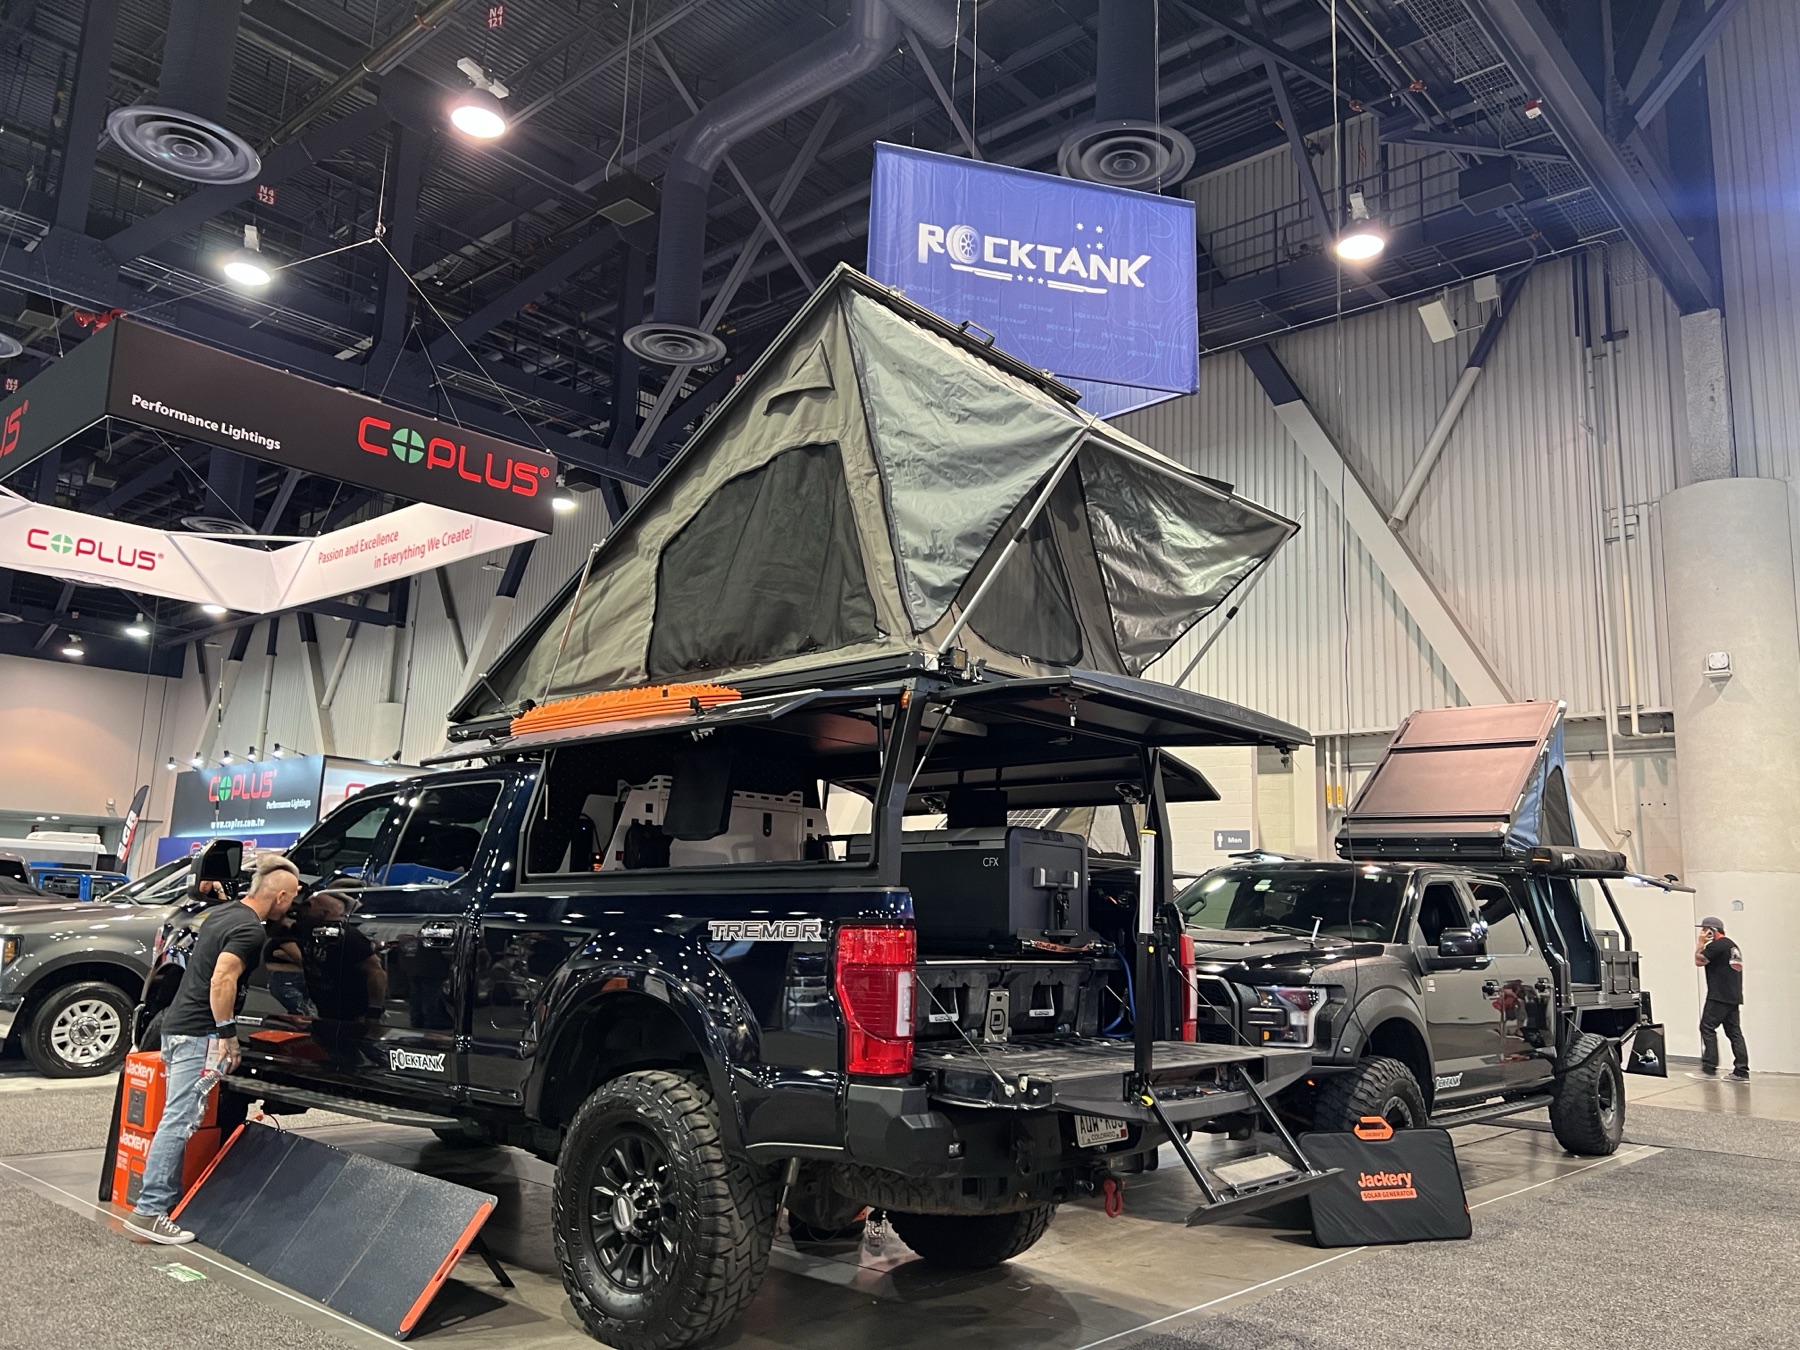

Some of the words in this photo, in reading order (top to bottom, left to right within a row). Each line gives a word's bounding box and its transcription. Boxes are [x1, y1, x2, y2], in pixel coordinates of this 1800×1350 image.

[490, 6, 503, 18] N4
[488, 16, 503, 28] 121
[258, 193, 274, 205] 123
[918, 222, 1152, 287] ROCKTANK
[131, 394, 219, 432] Performance
[220, 422, 281, 450] Lightings
[318, 548, 344, 565] Passion
[345, 539, 359, 556] and
[360, 530, 399, 553] Excellence
[374, 555, 382, 569] in
[383, 543, 425, 567] Everything
[427, 537, 440, 551] We
[442, 524, 473, 547] Create!
[1227, 836, 1243, 844] Men
[982, 857, 999, 867] CFX
[708, 920, 824, 941] TREMOR
[126, 1059, 155, 1084] Jackery
[120, 1127, 151, 1158] Jackery
[1357, 1171, 1412, 1188] Jackery
[1382, 1190, 1415, 1198] GENERATOR
